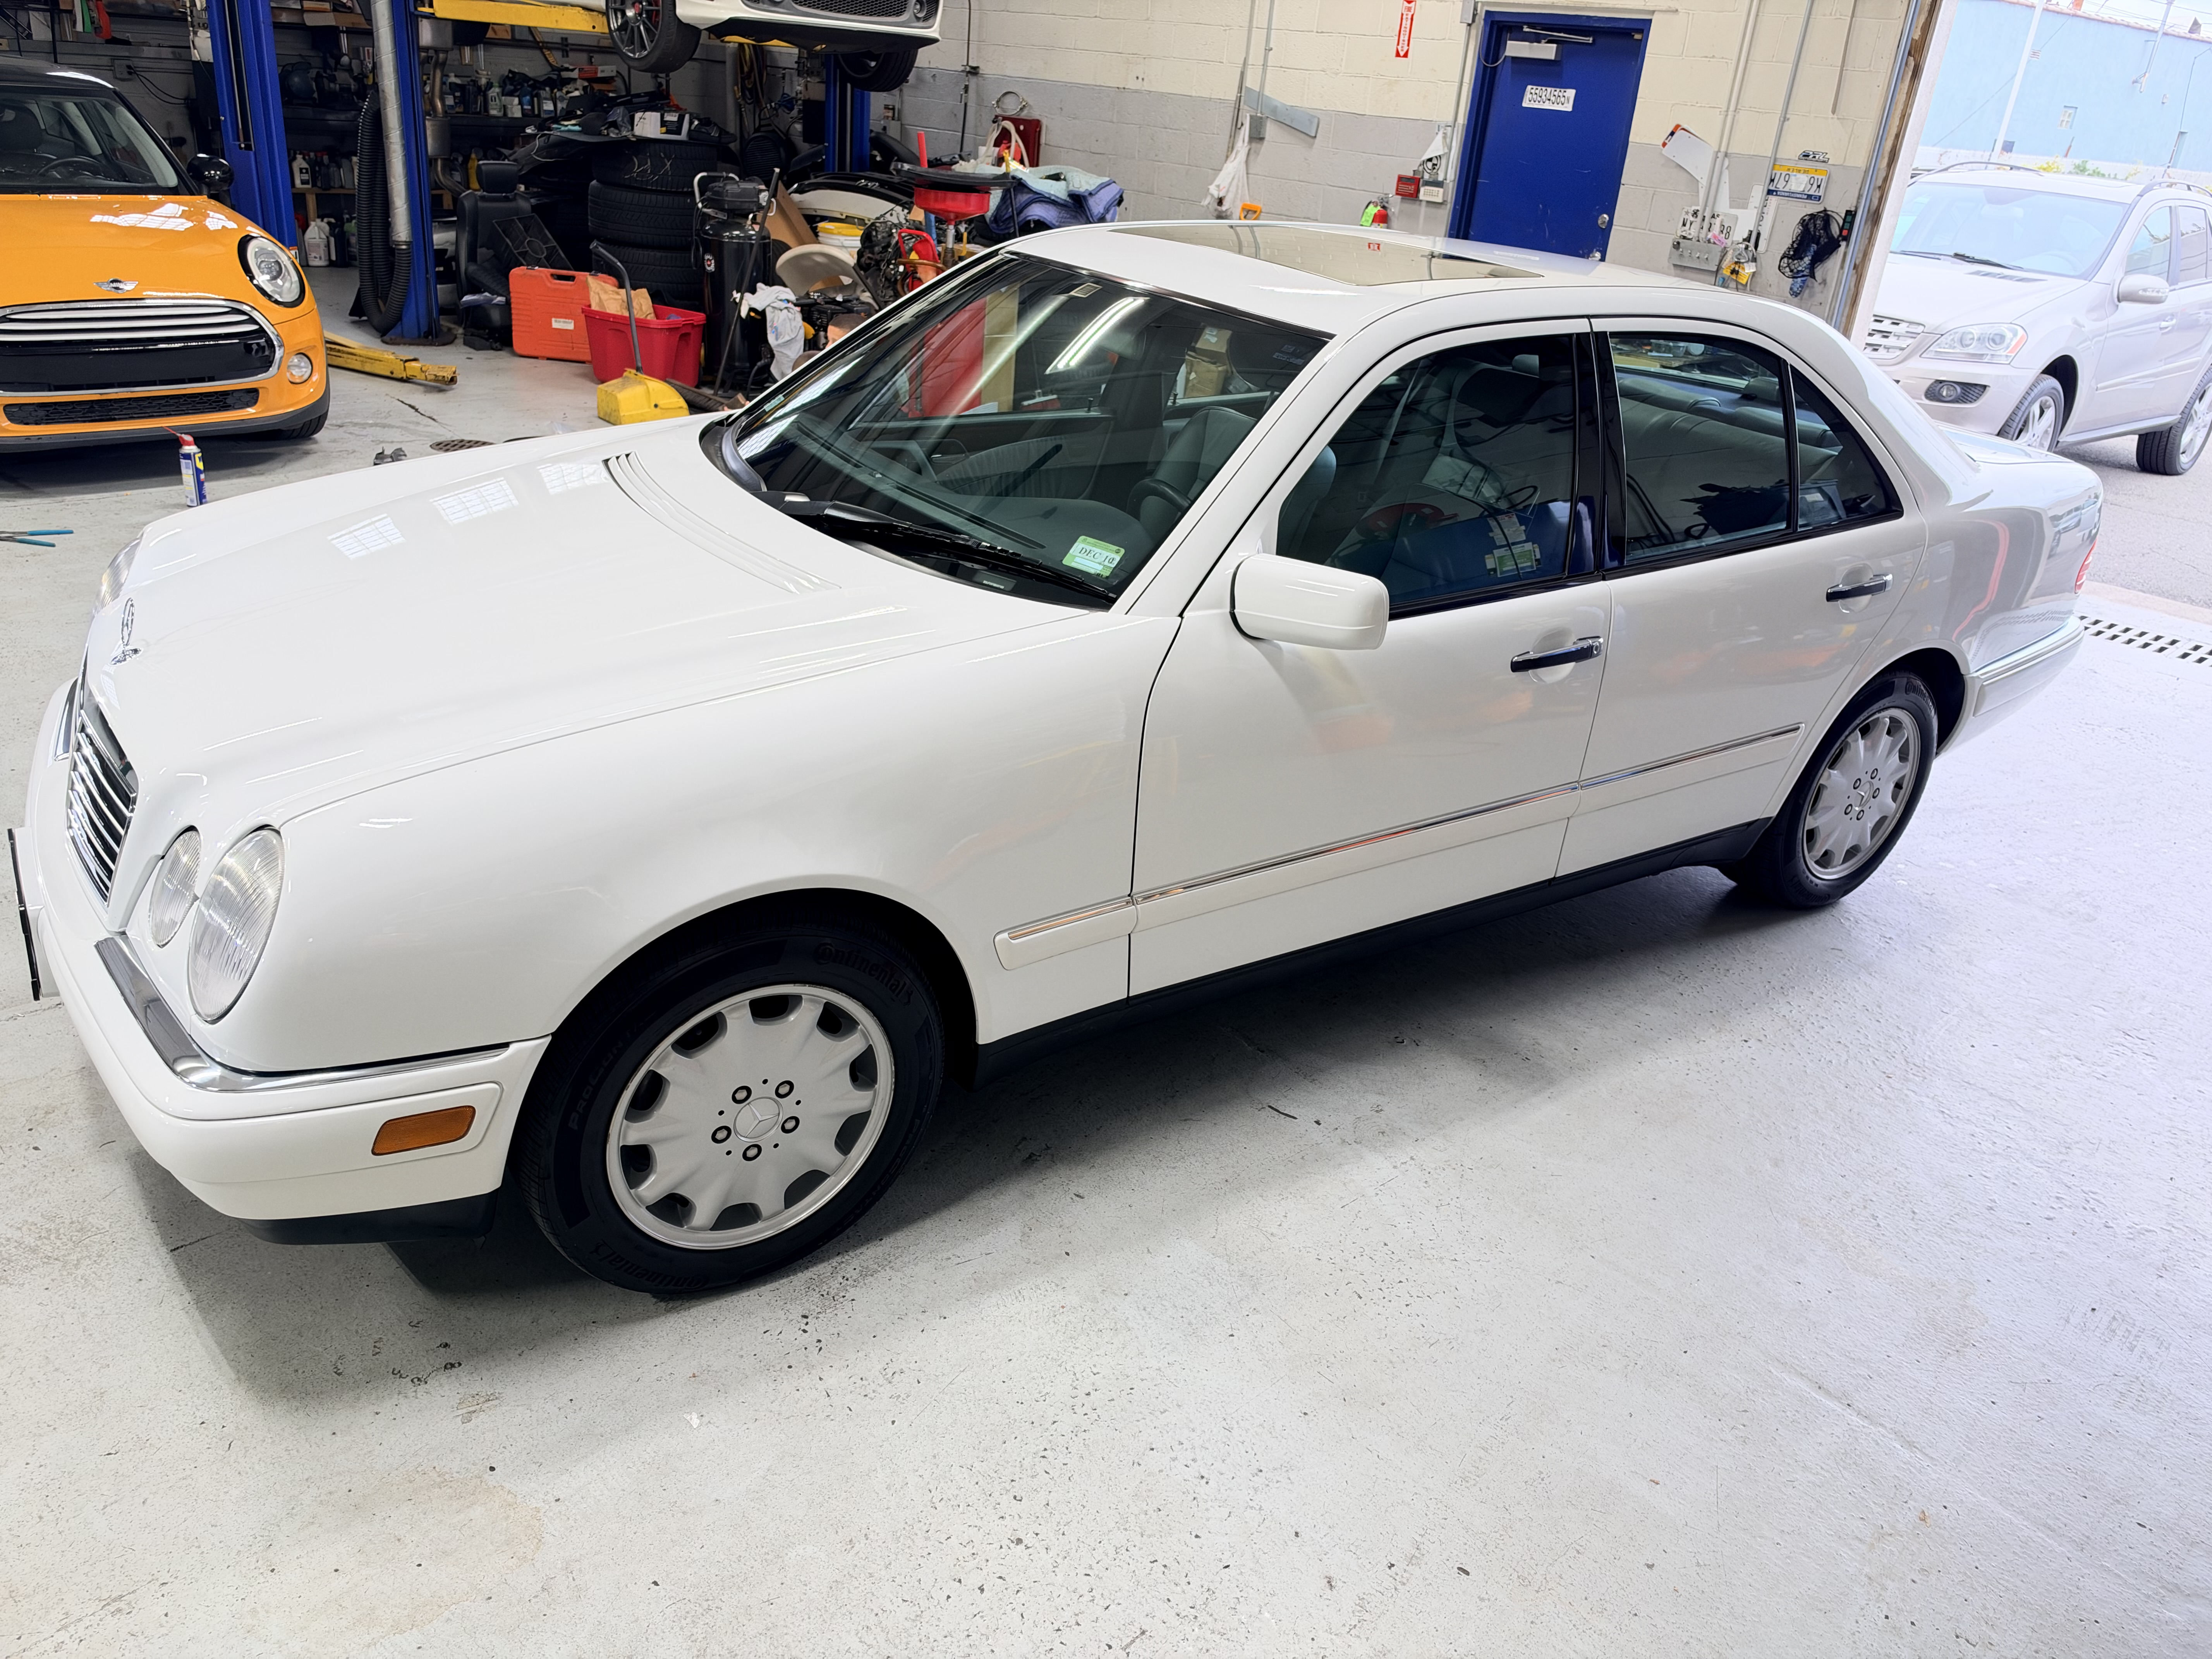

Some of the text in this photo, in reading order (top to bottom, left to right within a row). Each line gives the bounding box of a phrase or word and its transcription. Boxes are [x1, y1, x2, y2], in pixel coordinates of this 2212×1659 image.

[1079, 547, 1102, 560] DEC
[813, 941, 907, 998] Continental
[599, 1250, 710, 1290] Continental
